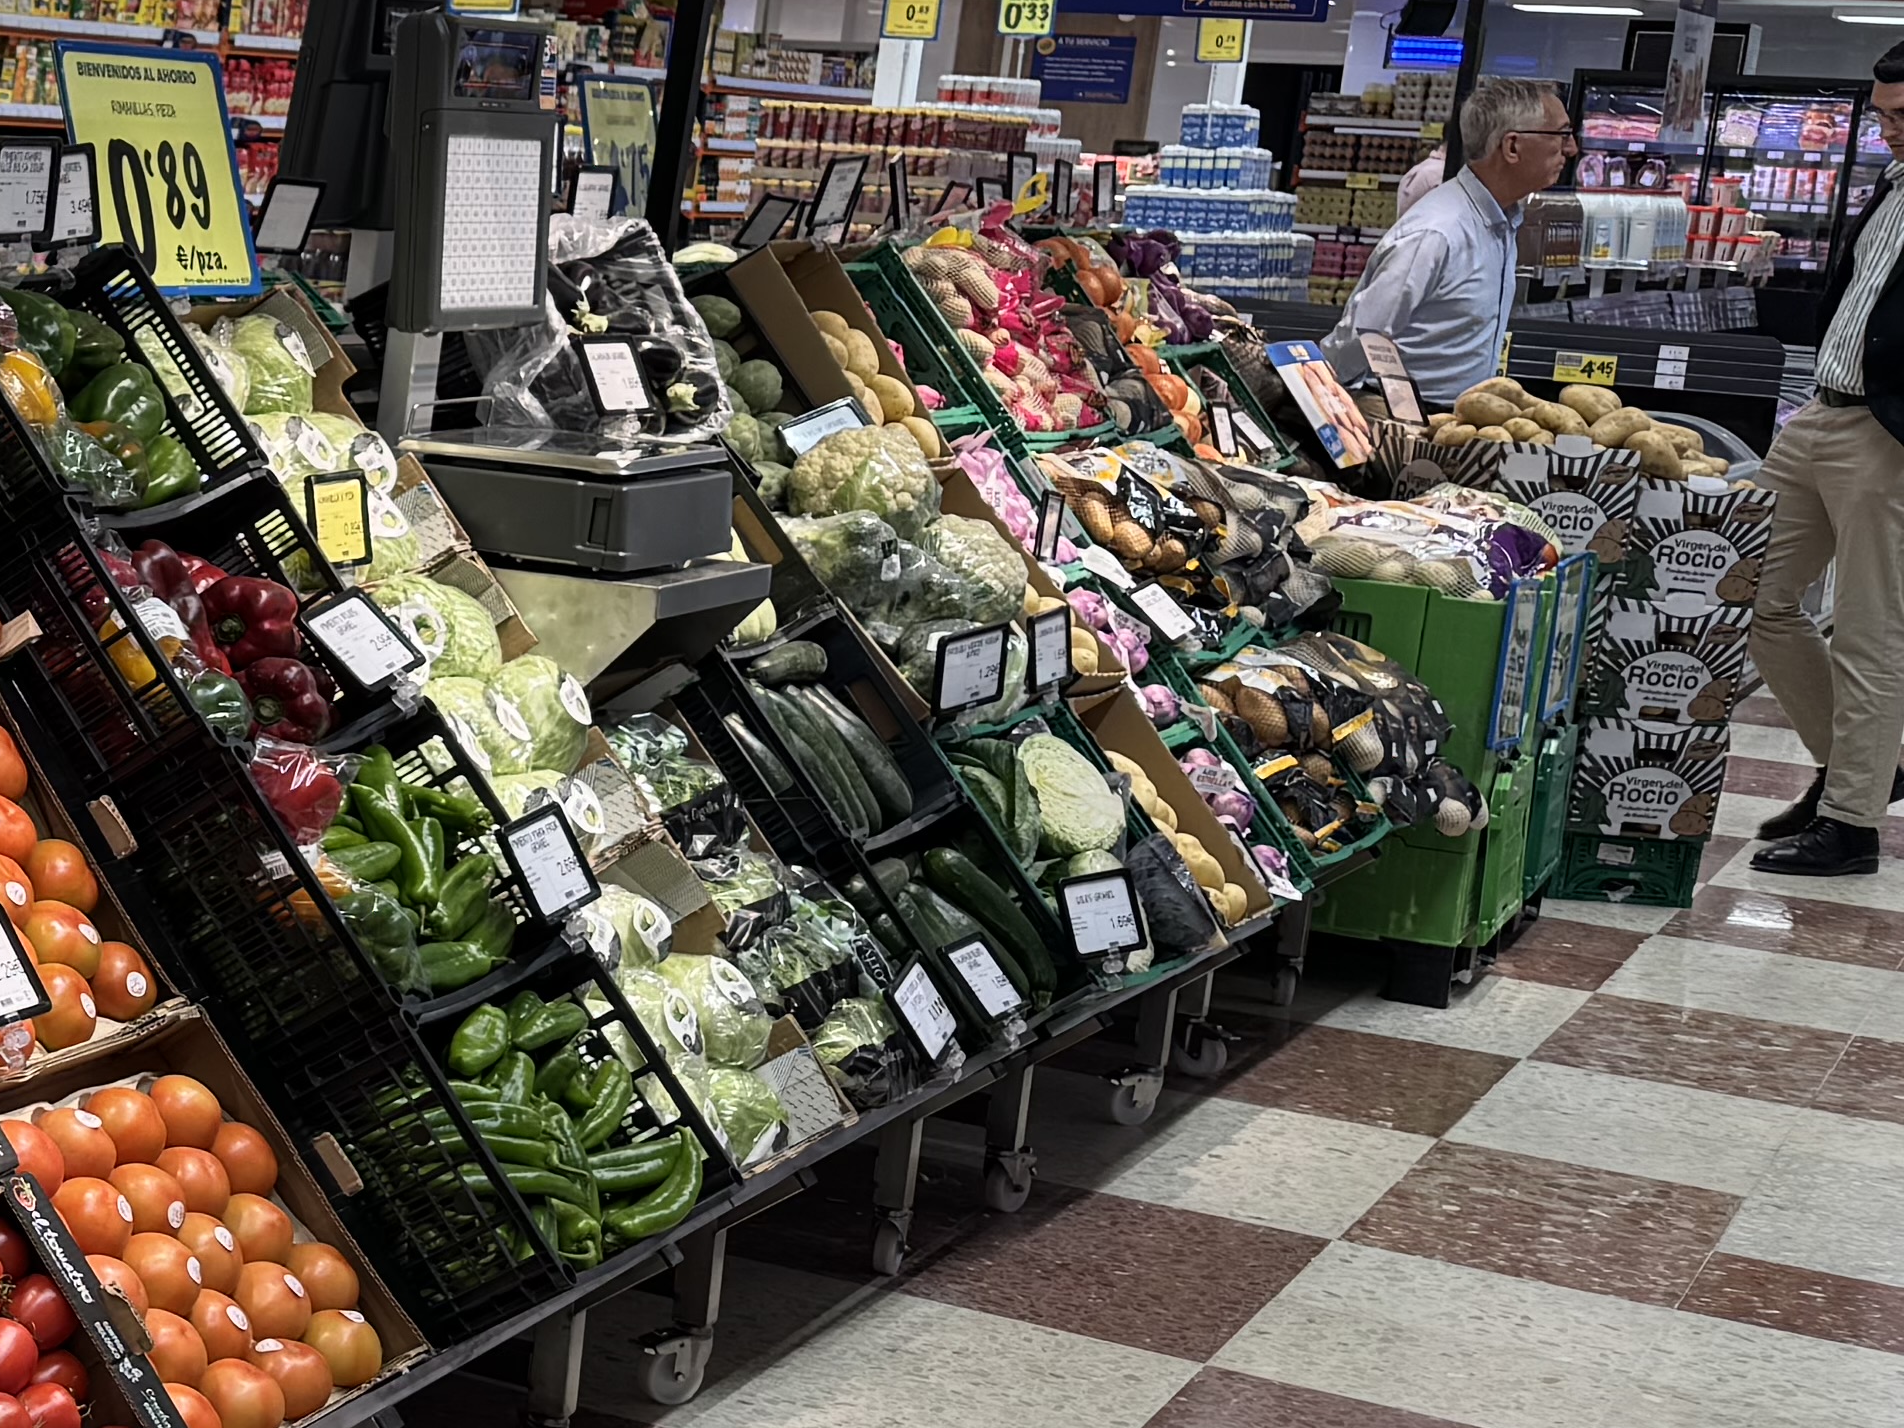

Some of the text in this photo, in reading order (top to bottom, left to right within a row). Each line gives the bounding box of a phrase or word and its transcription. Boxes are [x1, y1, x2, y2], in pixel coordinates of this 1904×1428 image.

[77, 62, 196, 84] BIENVENIDOS AL AHORRO
[176, 245, 227, 276] €/pza.
[1675, 539, 1731, 552] Virgen del
[1647, 660, 1704, 673] Virgen del
[1626, 776, 1684, 789] Virgen del
